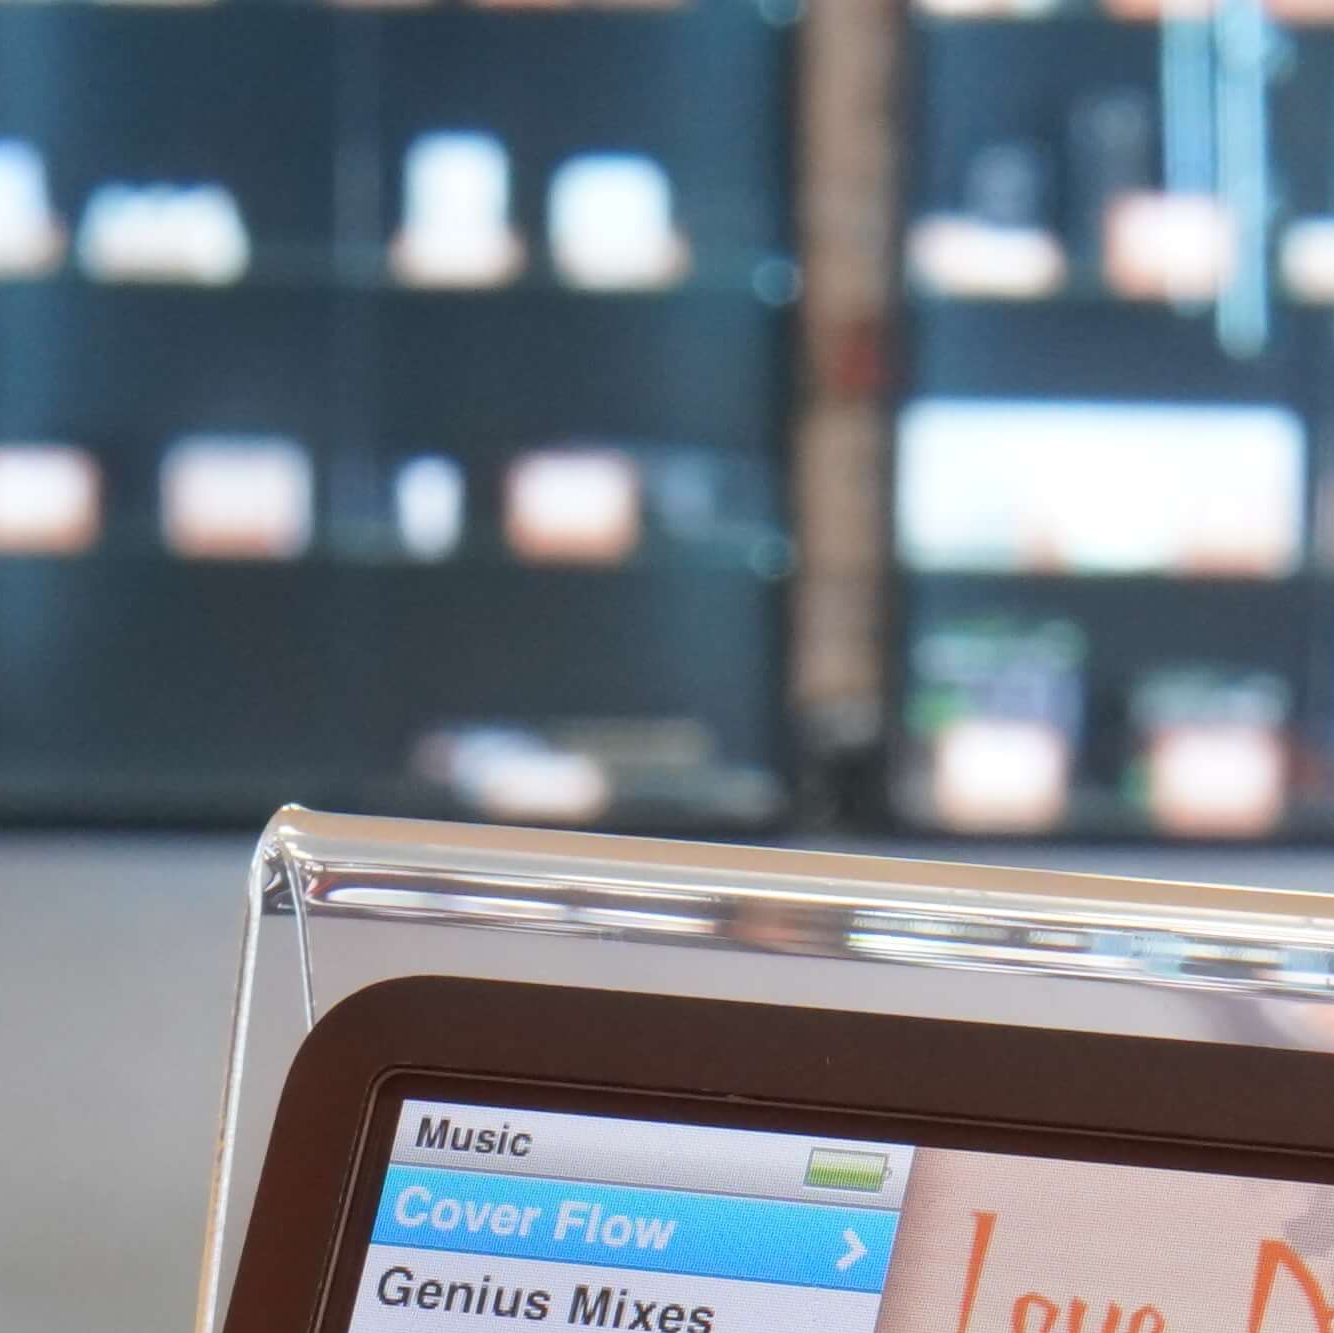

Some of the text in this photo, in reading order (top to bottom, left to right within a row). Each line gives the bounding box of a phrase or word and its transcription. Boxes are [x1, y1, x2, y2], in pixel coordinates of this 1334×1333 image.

[415, 1116, 533, 1157] Music
[393, 1186, 676, 1250] Cover Flow
[376, 1266, 551, 1321] Genius
